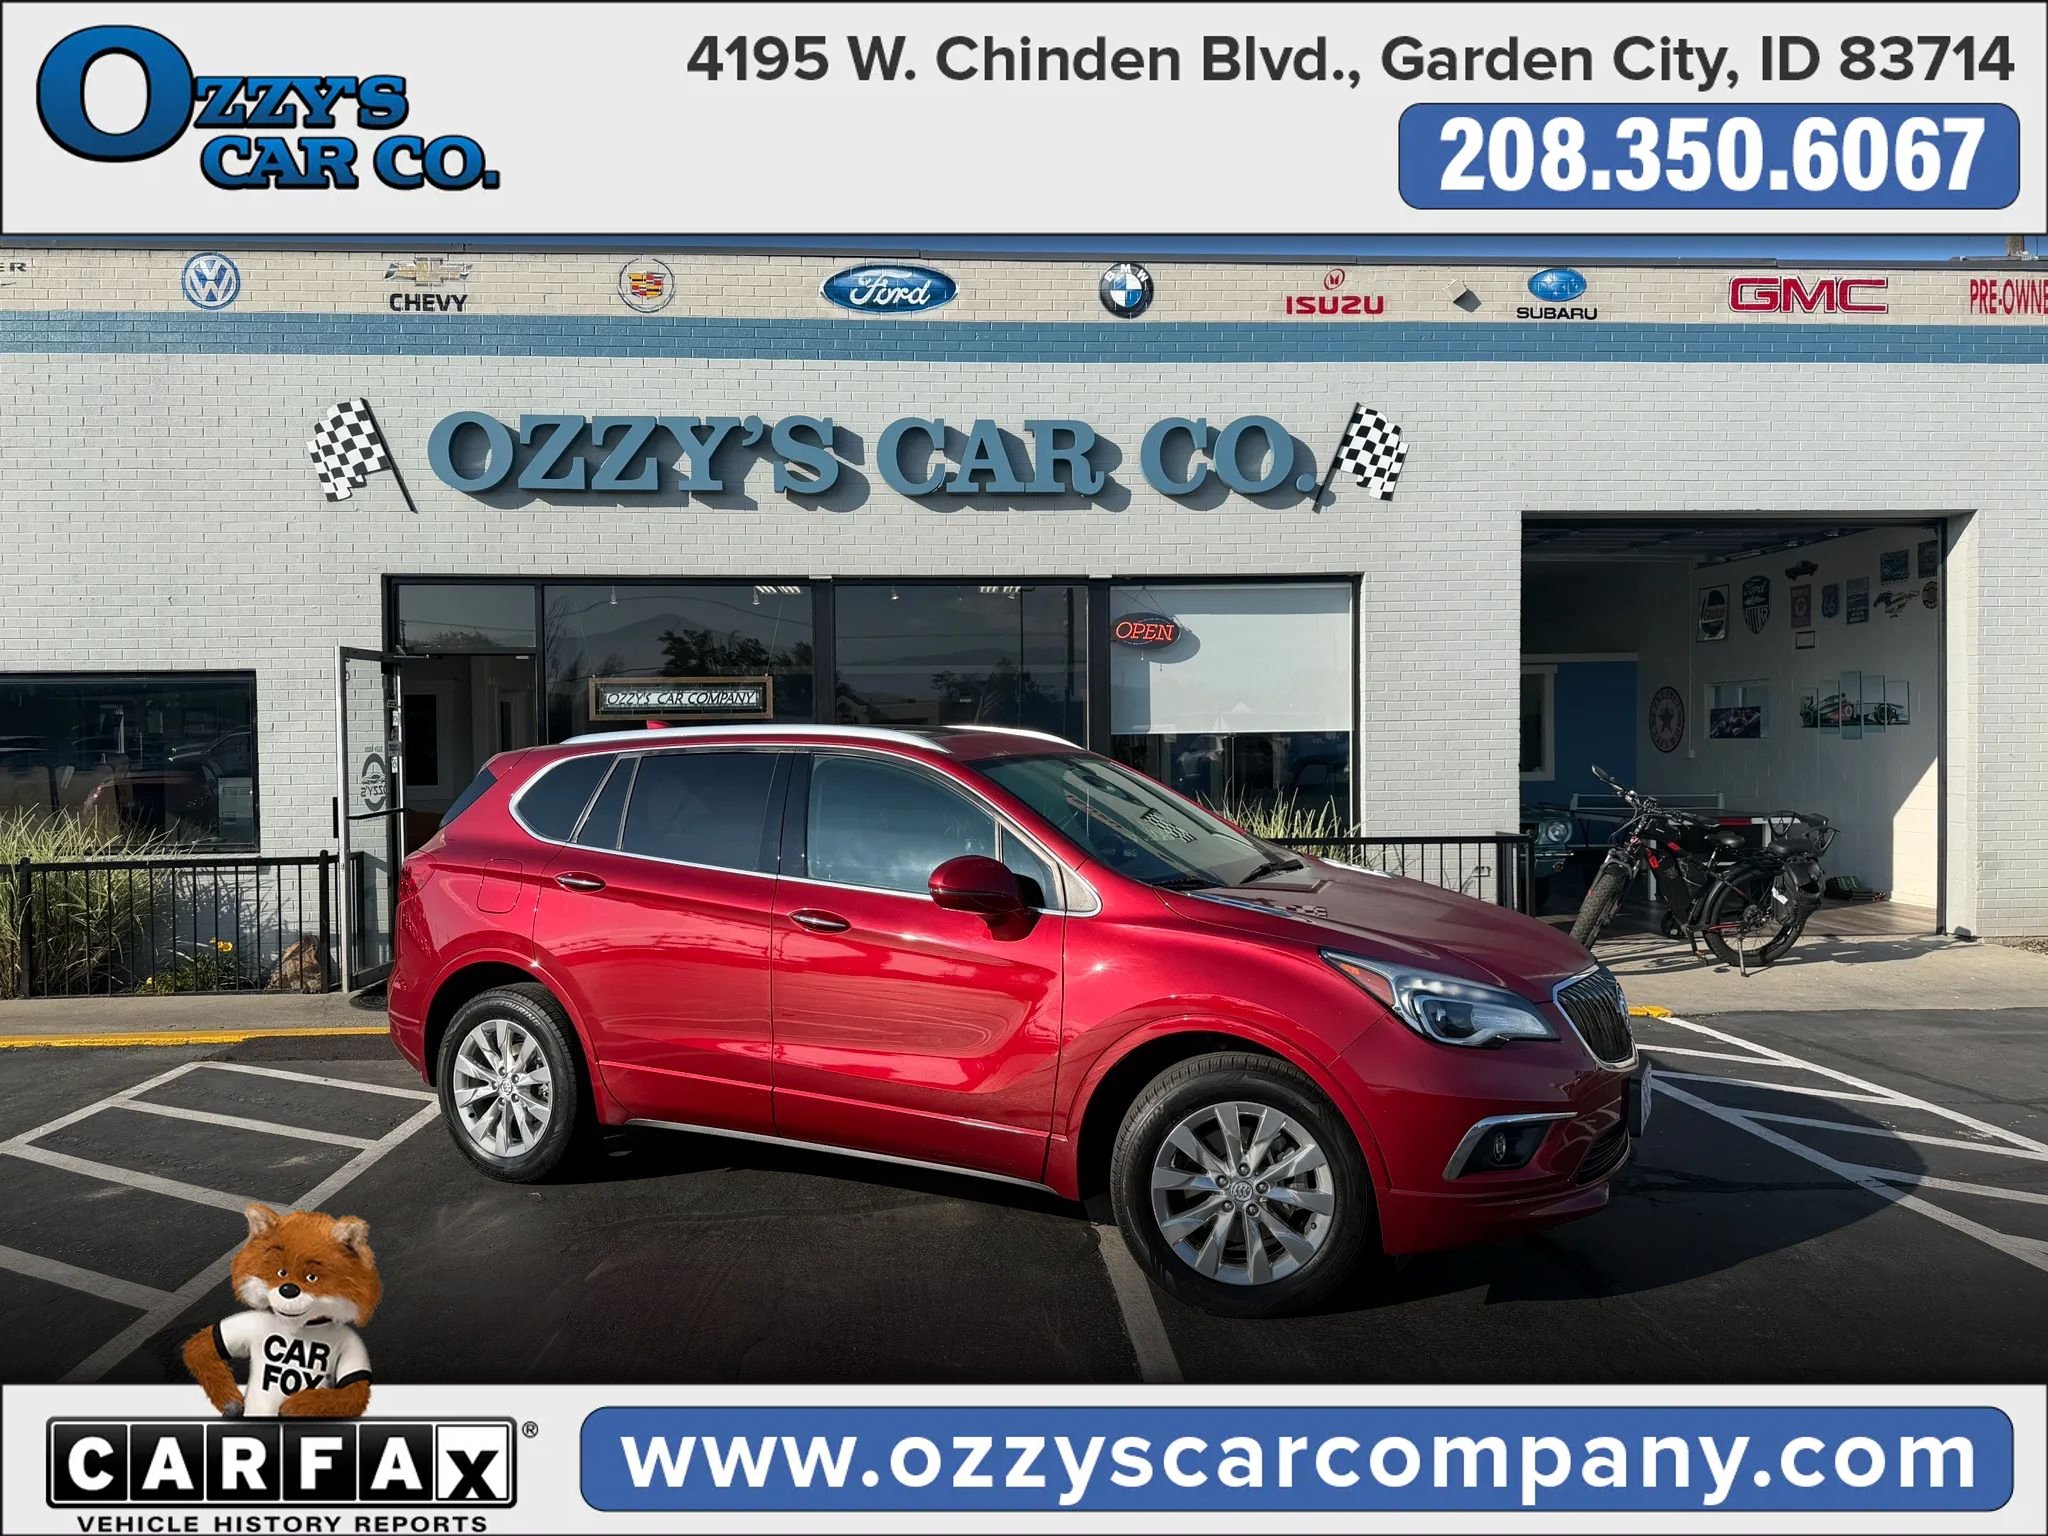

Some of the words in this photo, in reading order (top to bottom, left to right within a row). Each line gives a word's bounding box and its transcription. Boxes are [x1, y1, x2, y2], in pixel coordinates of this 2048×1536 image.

[1104, 263, 1149, 282] BMW
[849, 269, 932, 305] Ford
[1729, 276, 1888, 313] GMC
[389, 293, 468, 312] CHEVY
[1286, 296, 1384, 315] ISUZU
[1516, 307, 1598, 320] SUBARU
[428, 411, 839, 494] OZZY'S
[877, 416, 1105, 497] CAR
[1140, 415, 1317, 495] CO.
[1116, 621, 1174, 640] OPEN
[607, 692, 651, 705] OZZY'S
[657, 692, 683, 705] CAR
[687, 692, 754, 705] COMPANY
[500, 1000, 541, 1027] TOURING
